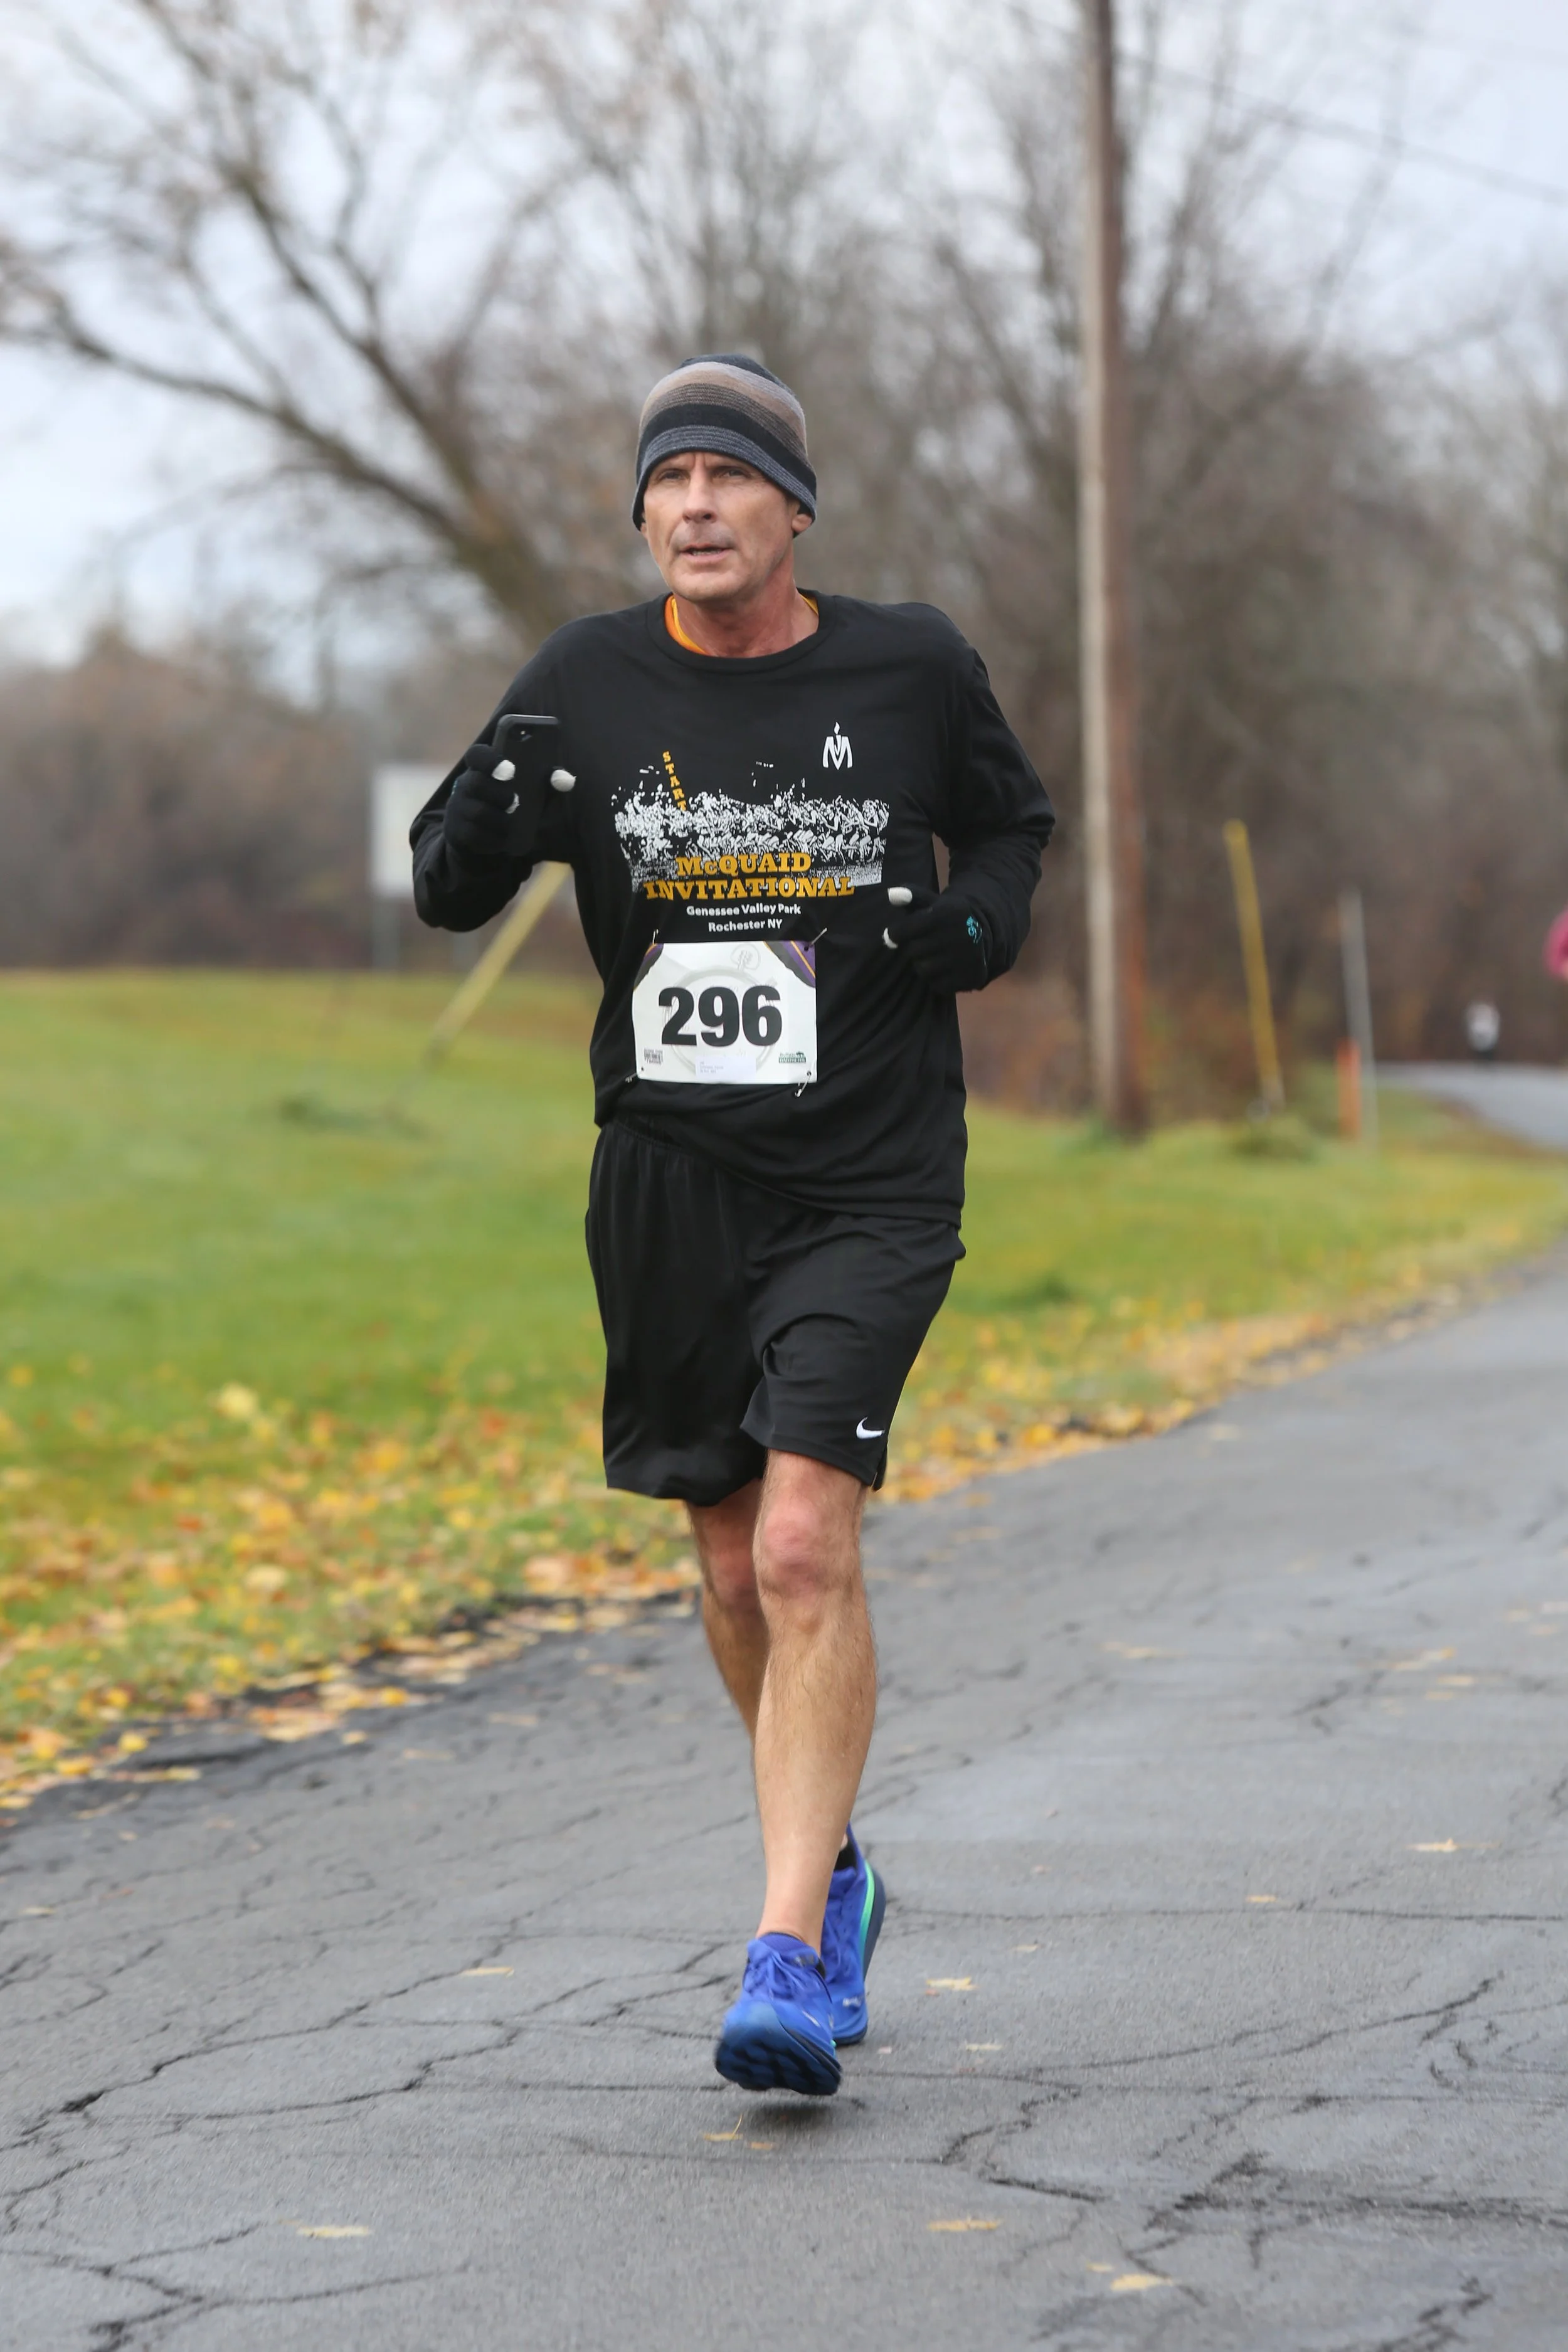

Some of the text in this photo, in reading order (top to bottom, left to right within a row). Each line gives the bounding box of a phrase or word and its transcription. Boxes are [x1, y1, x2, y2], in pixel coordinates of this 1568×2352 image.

[662, 751, 687, 810] START
[675, 852, 812, 877] McQUAID
[642, 877, 855, 901] INVITATIONAL
[686, 903, 802, 916] Genessee Valley Park
[708, 918, 783, 932] Rochester NY
[658, 985, 782, 1047] 296
